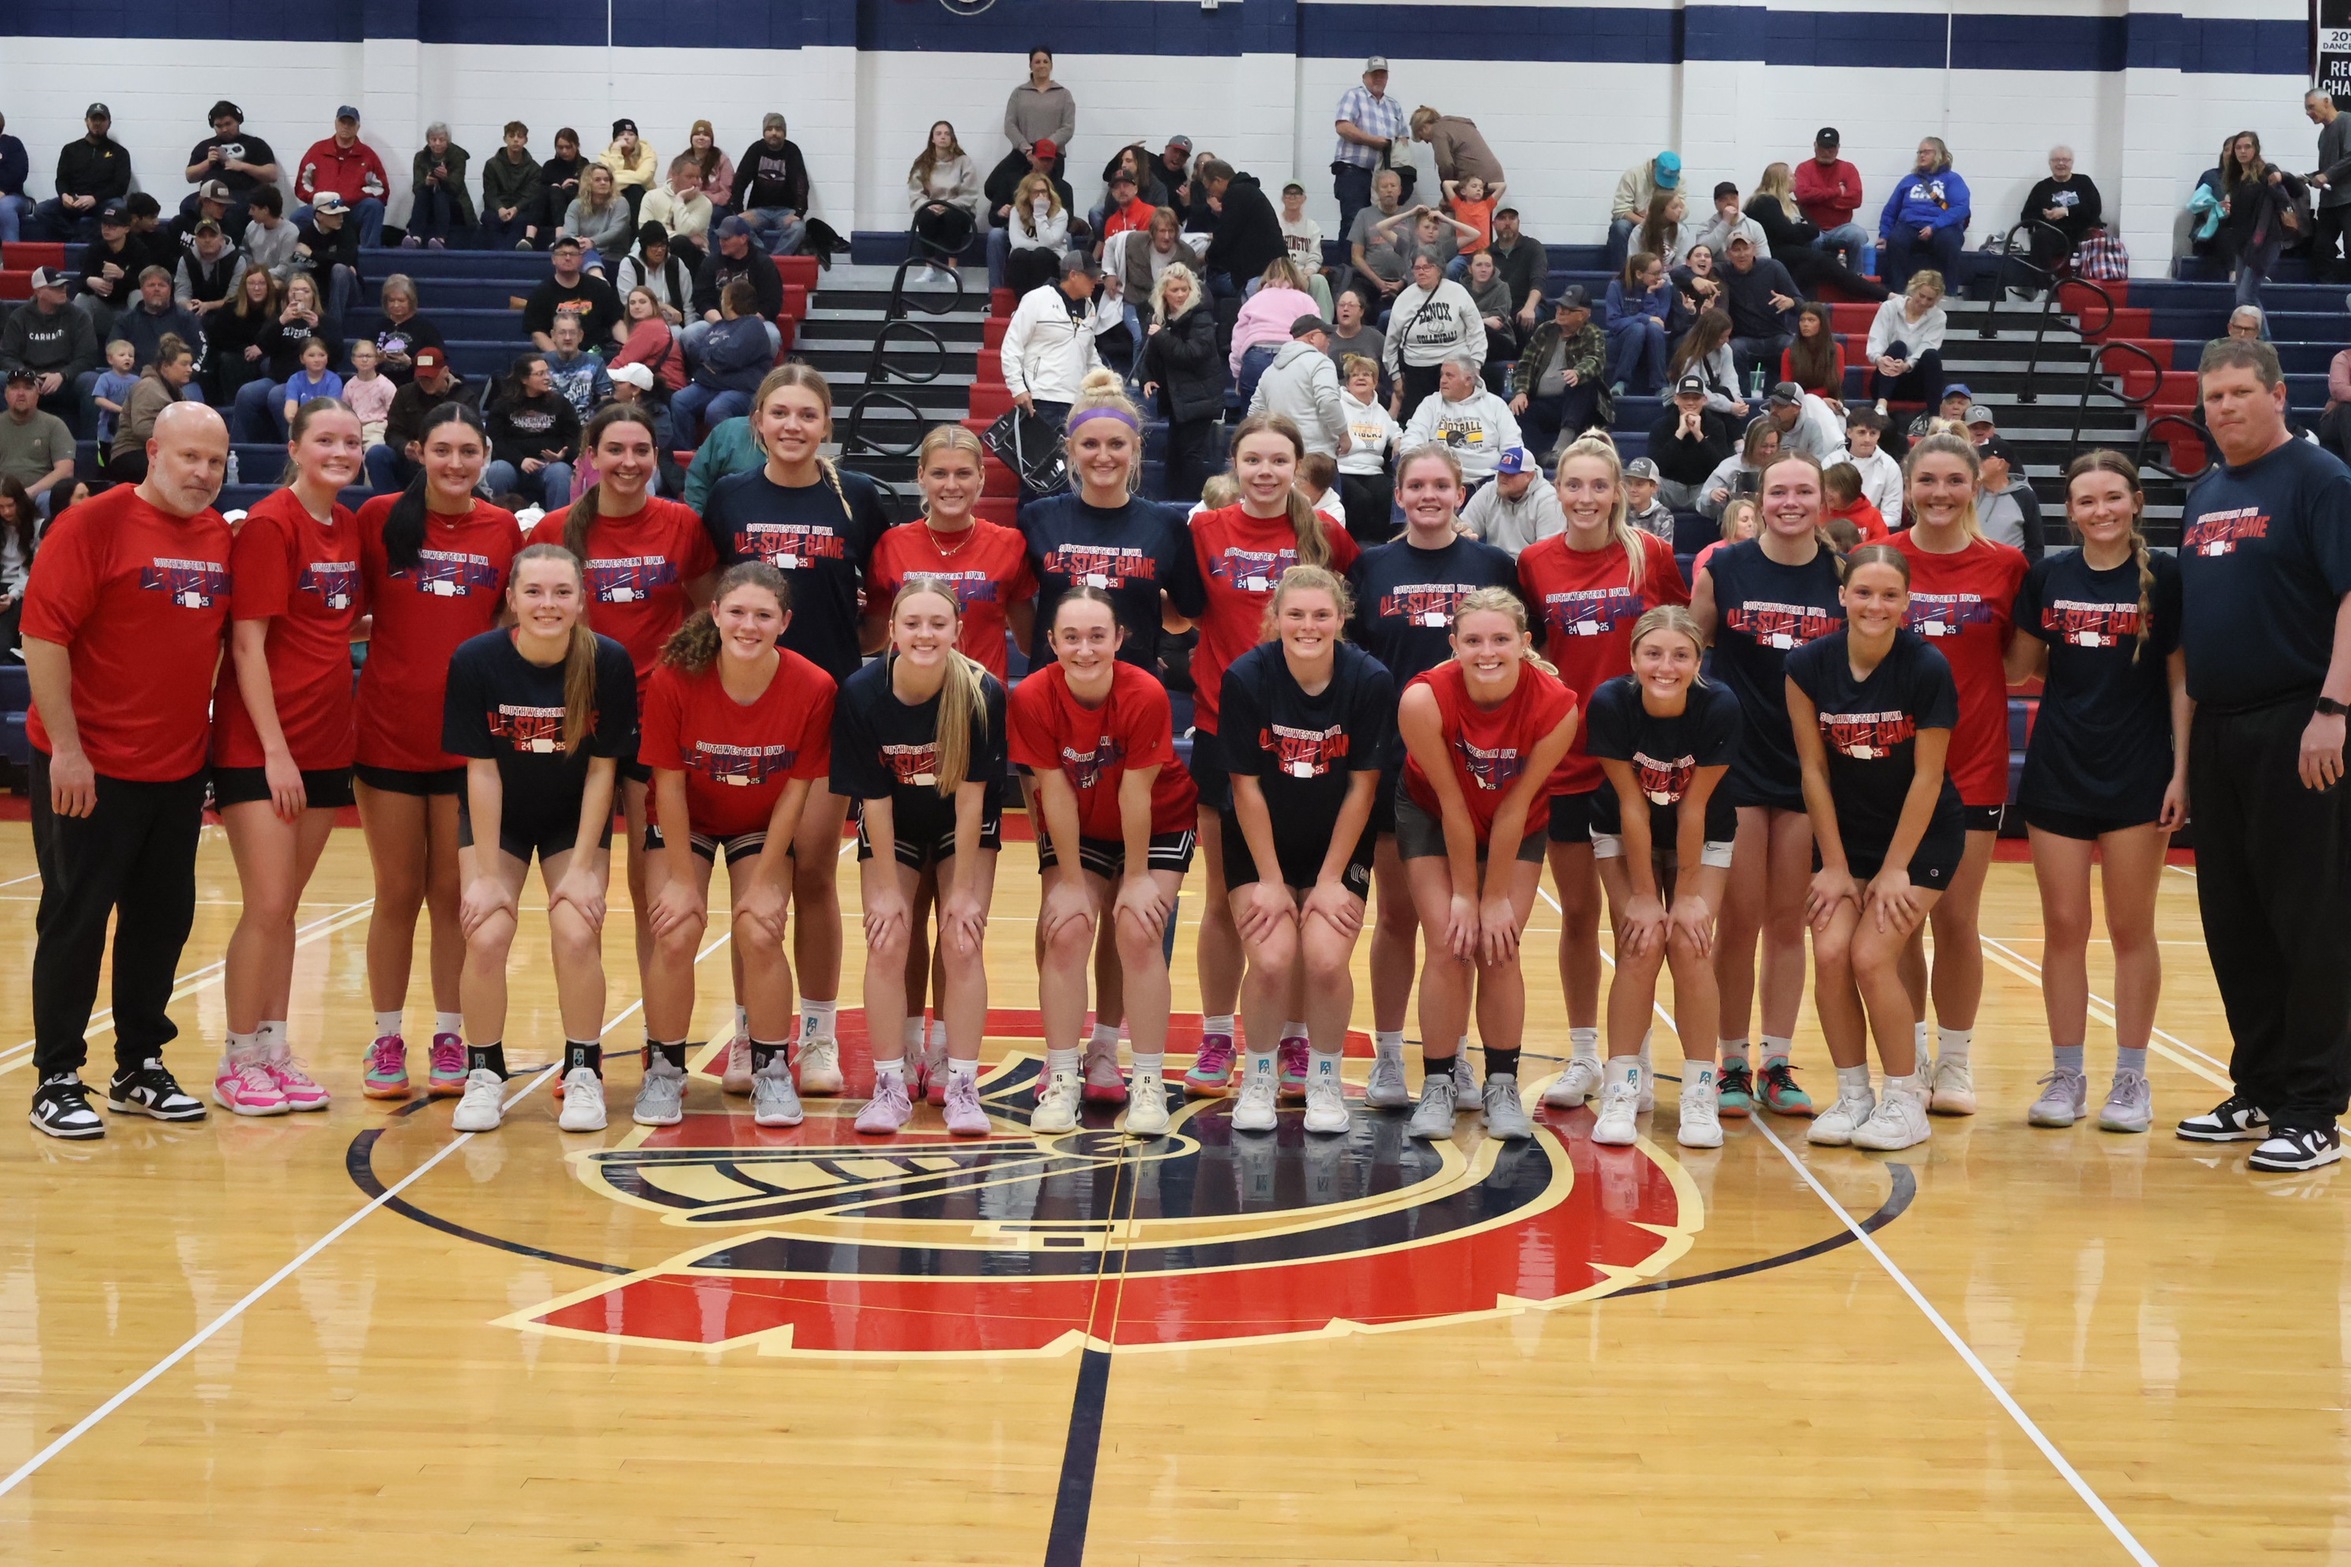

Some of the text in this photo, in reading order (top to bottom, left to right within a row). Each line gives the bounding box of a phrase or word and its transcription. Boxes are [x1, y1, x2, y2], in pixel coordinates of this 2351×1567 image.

[2332, 31, 2351, 42] 20
[1438, 420, 1482, 433] FOOTBALL
[2196, 509, 2241, 524] SOUTHWESTERN
[746, 523, 833, 536] SOUTHWESTERN IOWA
[2184, 515, 2271, 547] ALL-STAR GAME
[734, 532, 846, 560] ALL-STAR GAME
[1058, 544, 1142, 558] SOUTHWESTERN IOWA
[2201, 543, 2232, 555] 24 25
[154, 557, 223, 573] SOUTHWESTERN IOWA
[469, 553, 489, 566] IOWA
[583, 555, 665, 570] OUTHWESTERN IOWA
[766, 556, 808, 567] 24 25
[1043, 551, 1156, 580] ALL-STAR GAME
[965, 571, 986, 580] IOWA
[423, 582, 466, 595] 24 25
[1076, 577, 1118, 588] 24 25
[1237, 579, 1247, 588] 24
[602, 589, 645, 602] 24 25
[1393, 585, 1455, 595] SOUTHWESTERN
[1545, 588, 1630, 603] SOUTHWESTERN IOWA
[176, 594, 209, 606] 24 25
[1959, 593, 1981, 603] IOWA
[1379, 593, 1446, 618] ALL-STAR
[1742, 601, 1827, 618] SOUTHWESTERN IOWA
[2053, 600, 2138, 613] SOUTHWESTERN IOWA
[1415, 615, 1453, 625] 24 2
[1727, 608, 1795, 634] ALL-STAR
[2041, 608, 2102, 632] ALL-STAR
[1567, 622, 1609, 635] 24 25
[1913, 624, 1956, 635] 24 25
[1762, 636, 1803, 648] 24 25
[2069, 634, 2111, 645] 24 25
[499, 704, 566, 718] SOUTHWESTERN
[1819, 710, 1903, 724] SOUTHWESTERN IOWA
[487, 711, 556, 741] ALL-STAR
[1876, 714, 1916, 745] GAME
[521, 741, 566, 751] 24 25
[696, 740, 786, 756] SOUTHWESTERN IOWA
[1873, 748, 1884, 757] 25
[1500, 748, 1517, 759] IOW
[1283, 764, 1324, 774] 24 25
[716, 775, 760, 785] 24 25
[1082, 780, 1092, 788] 24
[1486, 782, 1496, 790] 25
[1670, 792, 1680, 801] 25
